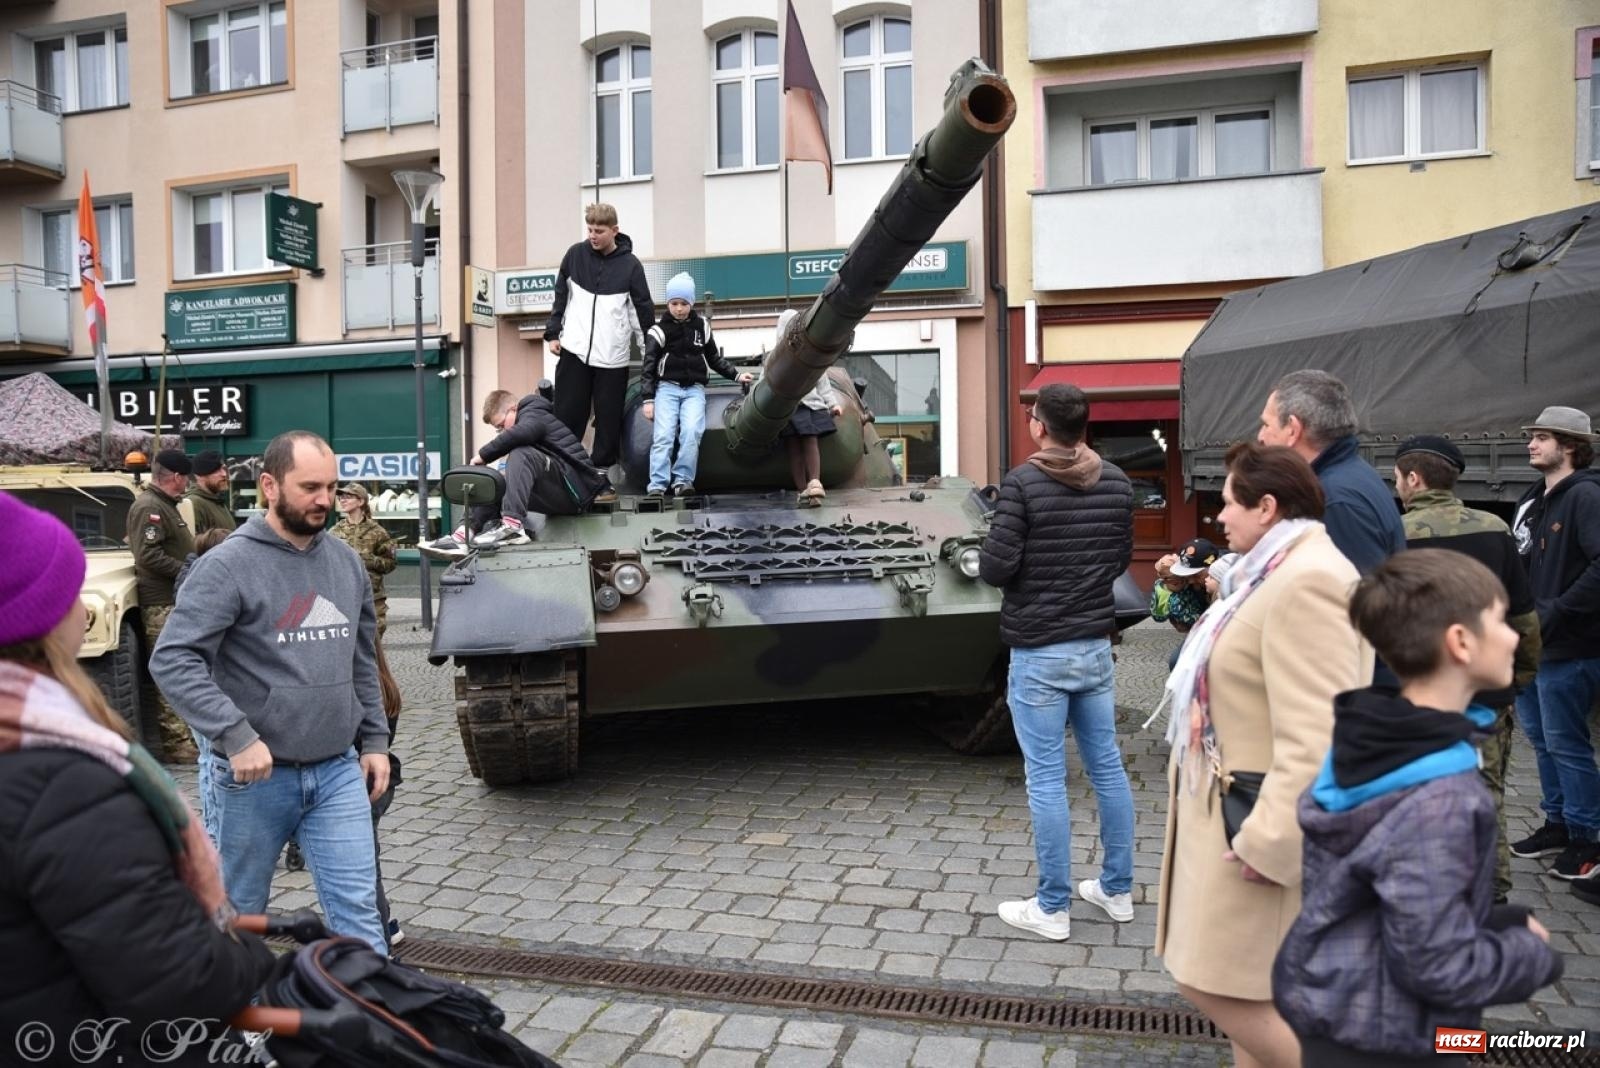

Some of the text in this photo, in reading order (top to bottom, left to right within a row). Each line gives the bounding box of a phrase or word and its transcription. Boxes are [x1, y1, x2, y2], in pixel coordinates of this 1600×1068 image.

[522, 278, 554, 290] KASA
[185, 294, 286, 311] KANCELARIE ADWOKACKIE
[339, 455, 431, 477] CASIO
[277, 627, 350, 643] ATHLETIC
